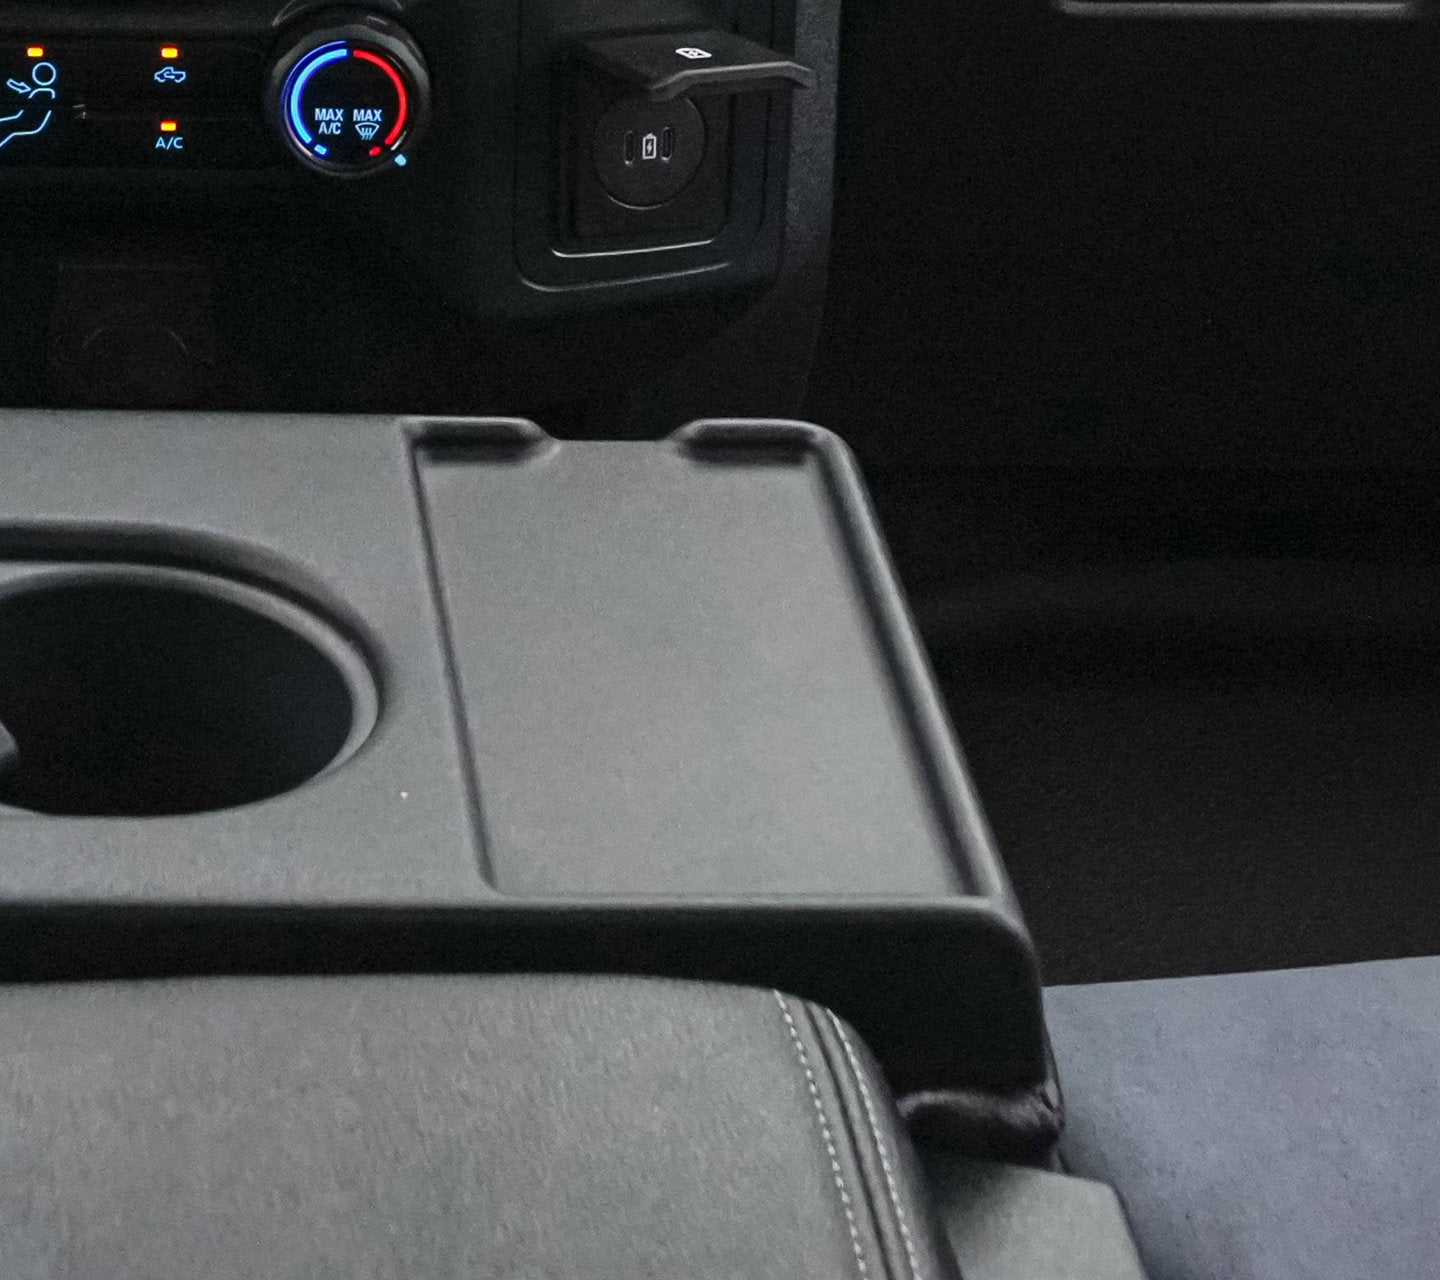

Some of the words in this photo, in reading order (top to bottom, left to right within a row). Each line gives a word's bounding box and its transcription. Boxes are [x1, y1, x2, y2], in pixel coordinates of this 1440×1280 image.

[315, 108, 344, 122] MAX
[353, 109, 383, 122] MAX
[318, 122, 342, 135] A/C
[155, 136, 183, 150] A/C
